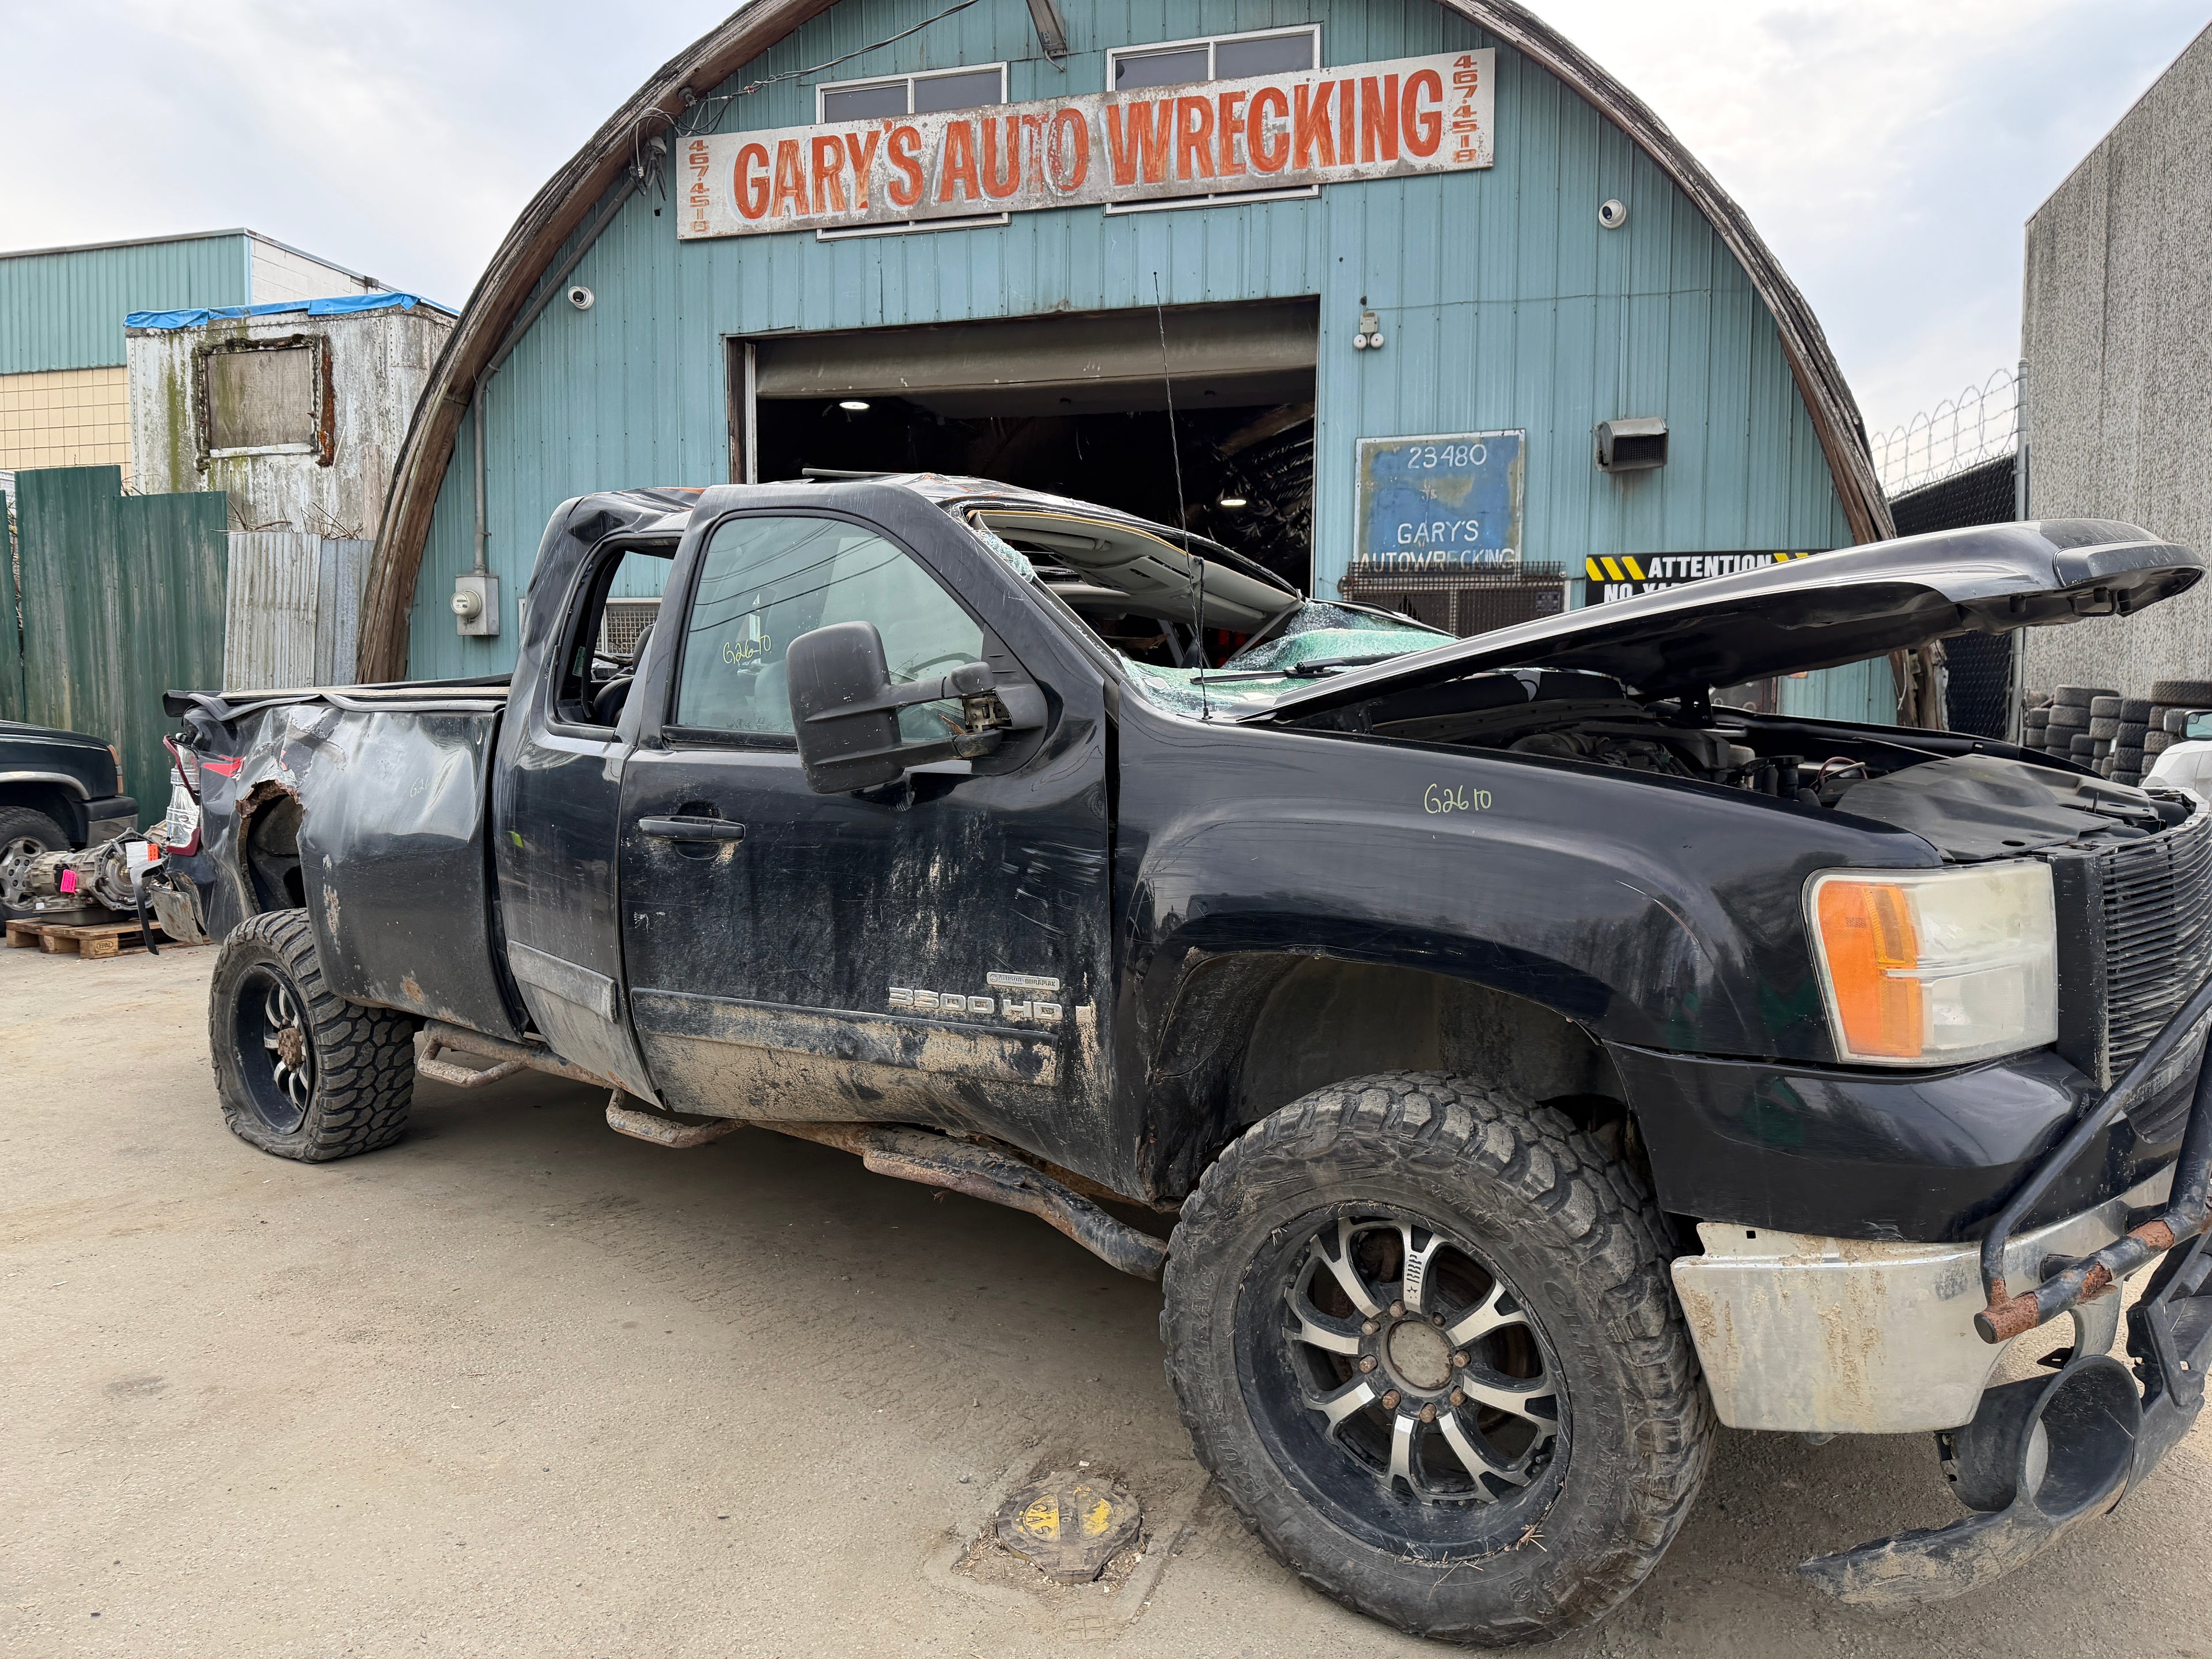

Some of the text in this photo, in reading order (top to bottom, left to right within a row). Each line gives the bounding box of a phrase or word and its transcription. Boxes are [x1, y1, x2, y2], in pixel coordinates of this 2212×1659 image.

[733, 69, 1443, 220] GARY'S AUTO WRECKING
[1407, 444, 1487, 469] 23480
[1397, 520, 1479, 544] GARY'S
[1647, 554, 1772, 578] ATTENTION
[1025, 978, 1056, 987] DURAMAX
[889, 987, 1063, 1021] 3500 HD
